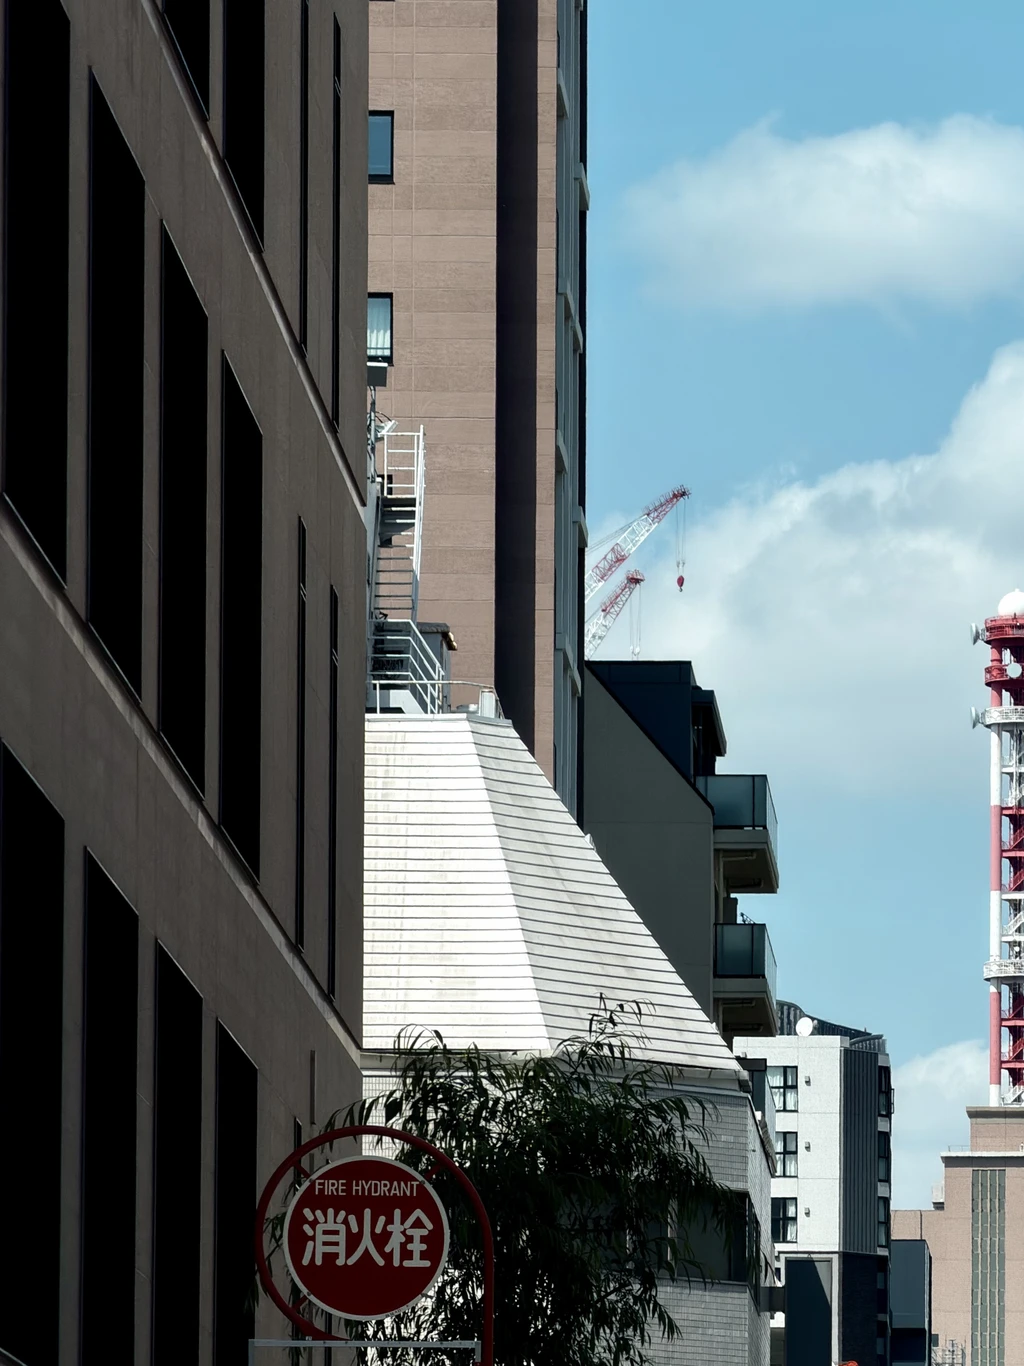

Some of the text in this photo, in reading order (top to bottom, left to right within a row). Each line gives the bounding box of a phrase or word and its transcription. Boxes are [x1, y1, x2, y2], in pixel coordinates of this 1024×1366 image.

[315, 1179, 420, 1197] FIRE HYDRANT
[301, 1207, 434, 1268] 消火栓
